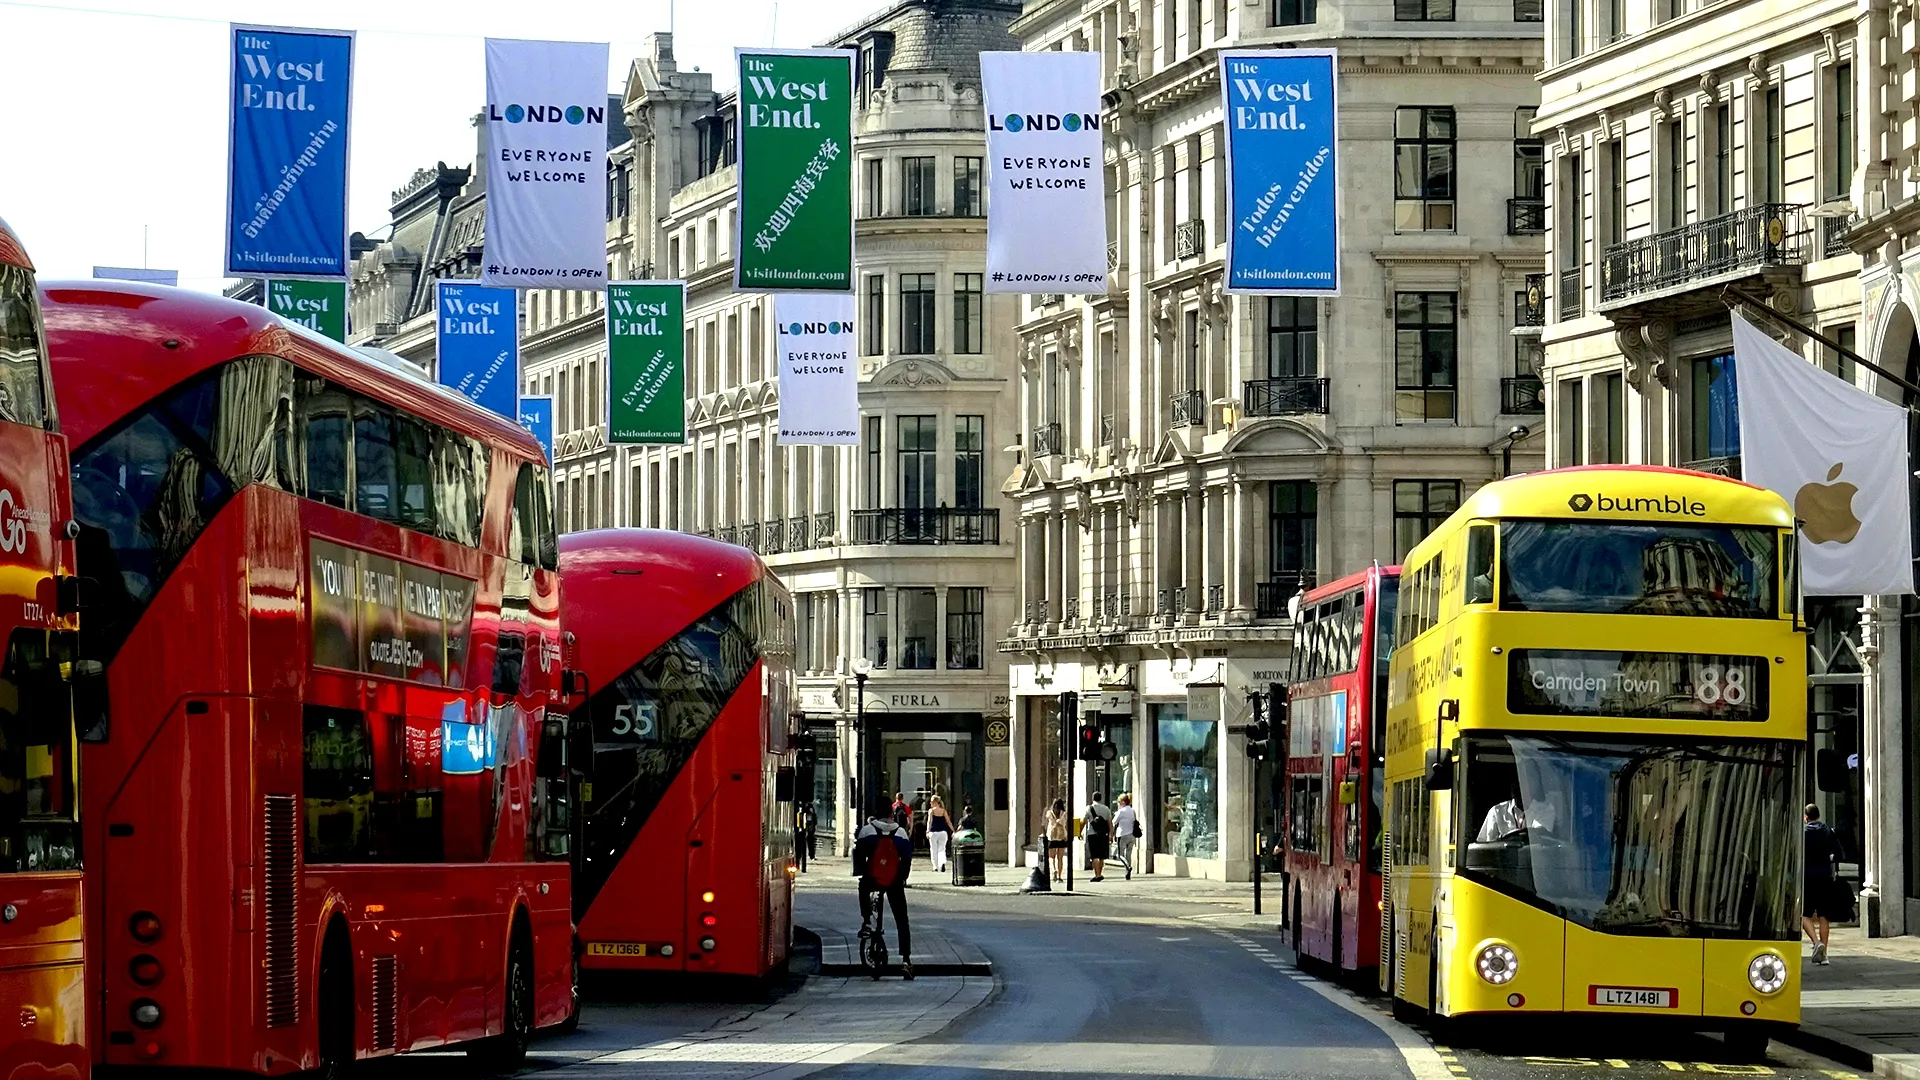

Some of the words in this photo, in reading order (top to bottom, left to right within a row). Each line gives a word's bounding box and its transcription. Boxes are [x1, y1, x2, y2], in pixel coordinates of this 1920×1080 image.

[242, 36, 271, 51] The
[242, 54, 325, 82] West
[745, 60, 774, 72] The
[1230, 62, 1258, 74] The
[748, 76, 830, 101] West
[1234, 79, 1313, 102] West
[242, 85, 315, 112] End.
[490, 104, 603, 126] LONDON
[748, 103, 821, 129] End.
[990, 113, 1100, 133] LONDON
[1236, 105, 1307, 131] End.
[501, 149, 593, 164] EVERYONE
[1003, 157, 1092, 170] EVERYONE
[507, 171, 586, 184] WELCOME
[1010, 177, 1086, 190] WELCOME
[753, 138, 840, 254] 欢迎四海宾客
[1256, 145, 1330, 248] bienvenidos
[1239, 182, 1282, 233] Todos
[746, 268, 845, 281] visitlondon.com
[1236, 268, 1331, 280] visitlondon.com
[273, 283, 293, 291] The
[443, 287, 463, 295] The
[611, 288, 631, 297] The
[274, 294, 329, 312] West
[444, 298, 500, 315] West
[613, 300, 668, 316] West
[444, 316, 495, 335] End.
[614, 318, 663, 335] End.
[779, 321, 854, 336] LONDON
[788, 351, 847, 361] EVERYONE
[621, 349, 664, 406] Everyone
[793, 366, 844, 375] WELCOME
[635, 361, 675, 413] welcome
[613, 429, 681, 438] visitlondon.com
[1597, 492, 1706, 517] bumble
[363, 569, 377, 603] BE
[377, 572, 399, 609] WITH
[415, 582, 426, 616] IN
[1253, 671, 1284, 680] MOLTON
[1531, 669, 1606, 692] Camden
[1613, 672, 1660, 693] Town
[1697, 667, 1746, 705] 88
[891, 694, 940, 707] FURLA
[612, 704, 653, 735] 55
[593, 944, 614, 955] LTZ
[616, 944, 640, 955] 1366
[1606, 990, 1632, 1004] LTZ
[1636, 992, 1660, 1005] 1481
